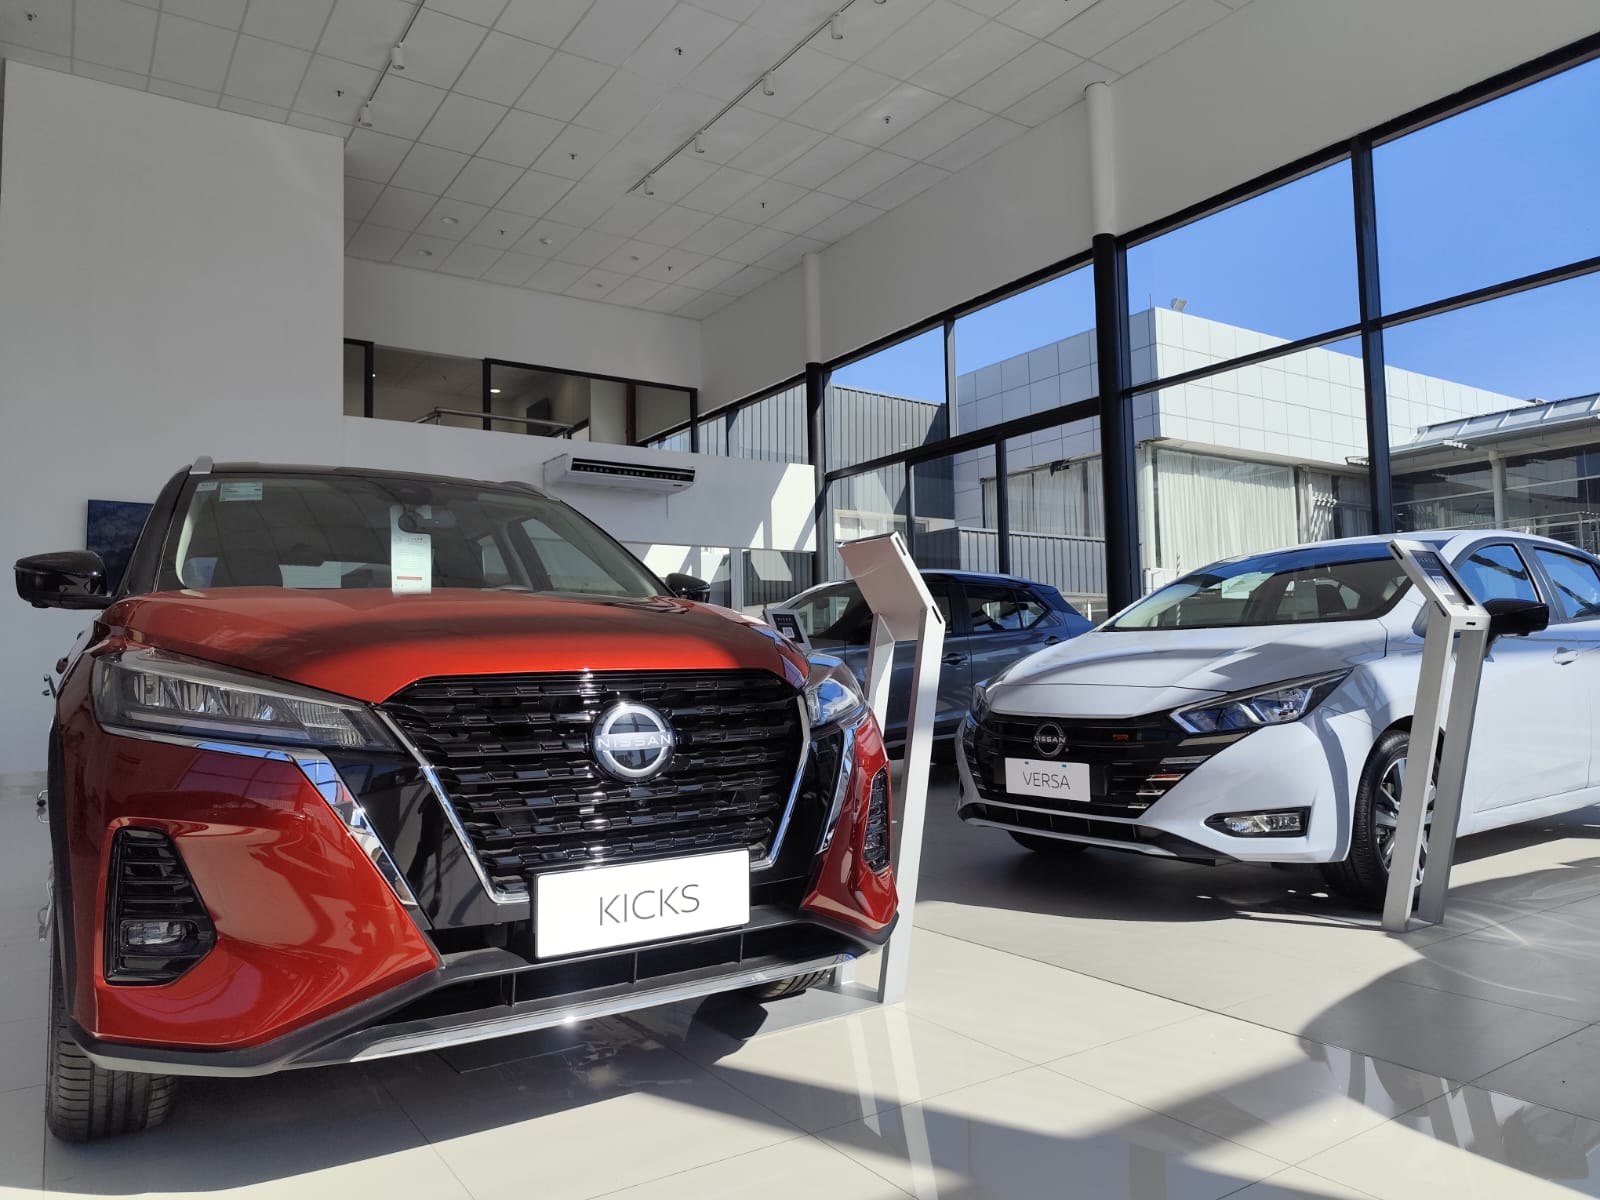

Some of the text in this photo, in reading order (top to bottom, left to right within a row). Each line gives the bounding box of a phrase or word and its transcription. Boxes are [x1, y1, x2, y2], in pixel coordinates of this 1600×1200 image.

[597, 734, 671, 748] NISSAN
[1033, 735, 1066, 744] NISSAN
[1022, 771, 1071, 790] VERSA
[599, 884, 700, 926] KICKS
